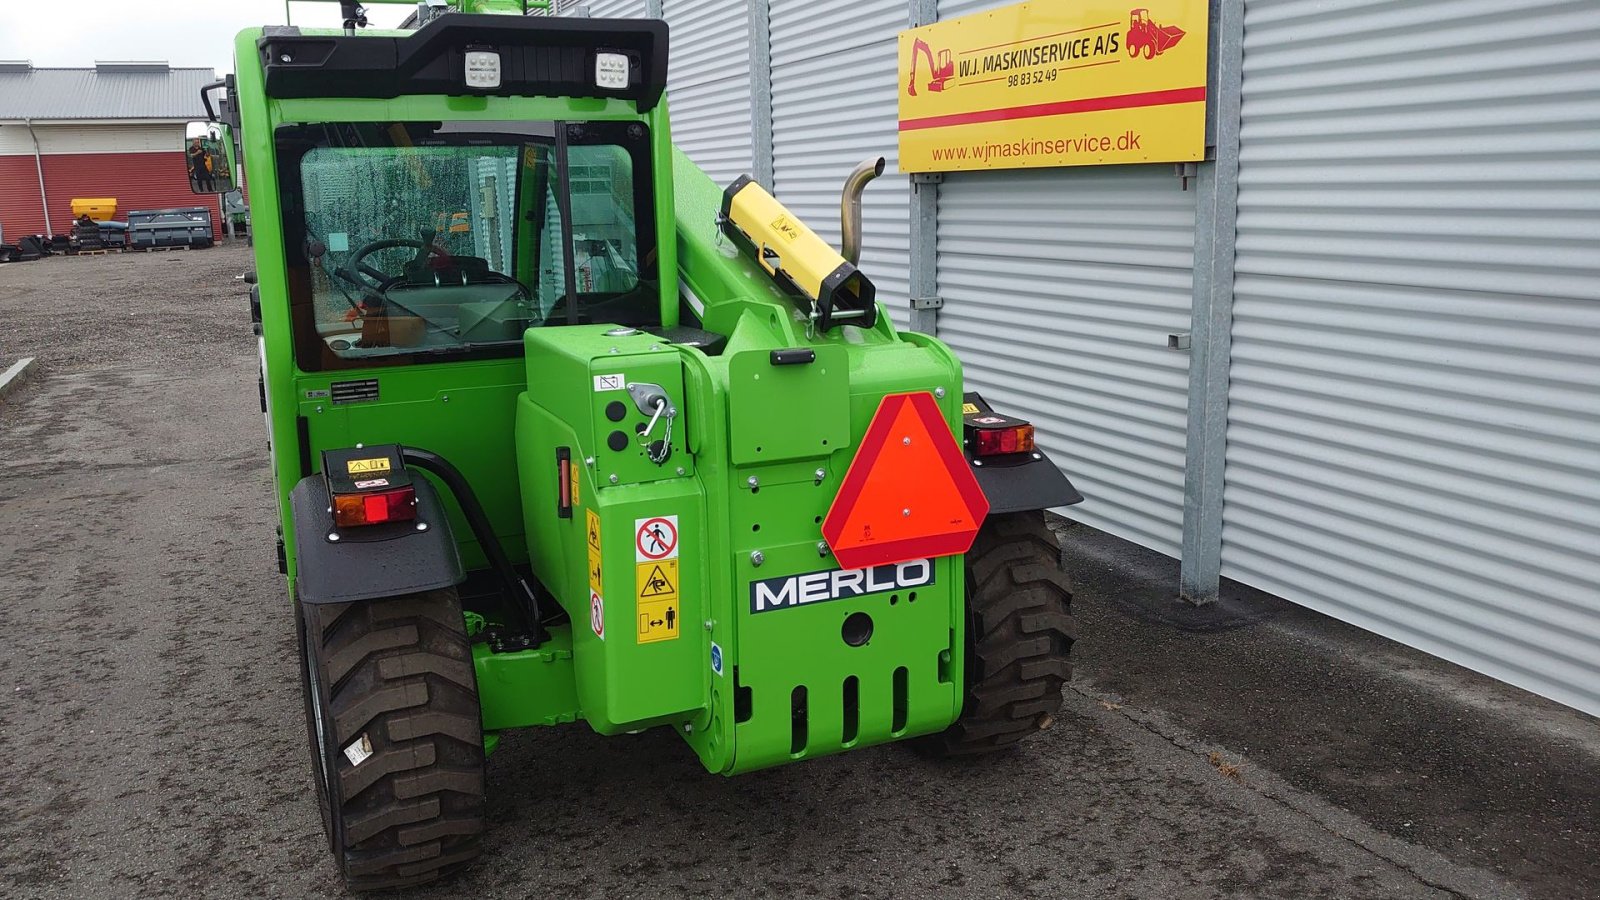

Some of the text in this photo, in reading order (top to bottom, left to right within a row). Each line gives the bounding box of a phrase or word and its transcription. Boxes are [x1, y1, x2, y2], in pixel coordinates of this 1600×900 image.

[959, 32, 1120, 78] W.J. MASKINSERVICE A/S
[1007, 68, 1058, 87] 98 83 52 49
[932, 131, 1140, 163] www.wjmaskinservice.dk
[755, 558, 931, 611] MERLO
